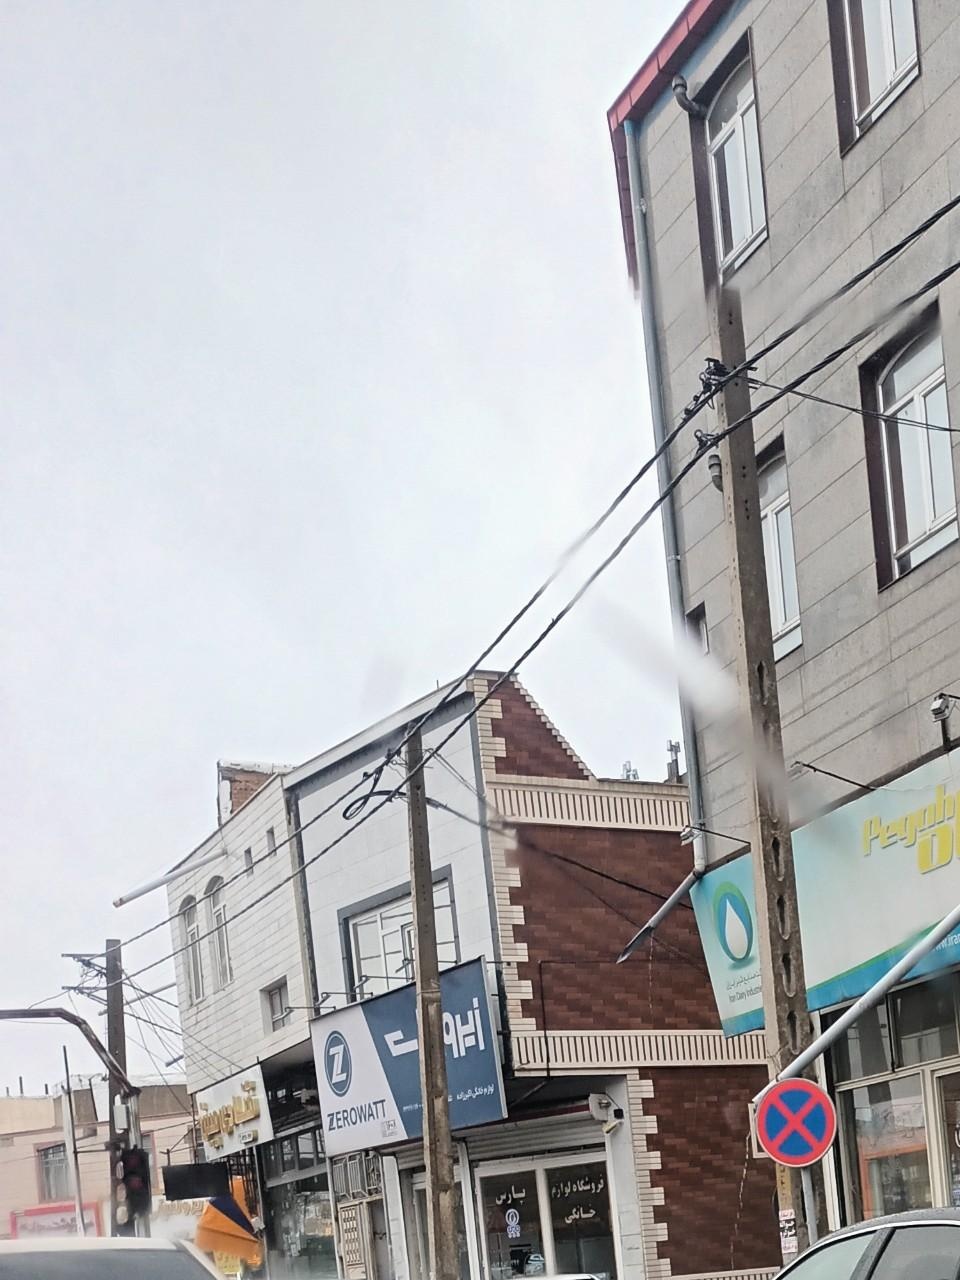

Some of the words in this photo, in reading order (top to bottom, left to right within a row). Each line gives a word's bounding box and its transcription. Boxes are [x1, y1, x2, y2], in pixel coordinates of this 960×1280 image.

[862, 783, 956, 858] Pegah
[326, 1099, 386, 1132] ZEROWATT
[495, 1184, 526, 1205] پارس
[551, 1181, 571, 1199] لوازم
[572, 1174, 605, 1194] فروشگاه
[564, 1203, 596, 1224] خانگی
